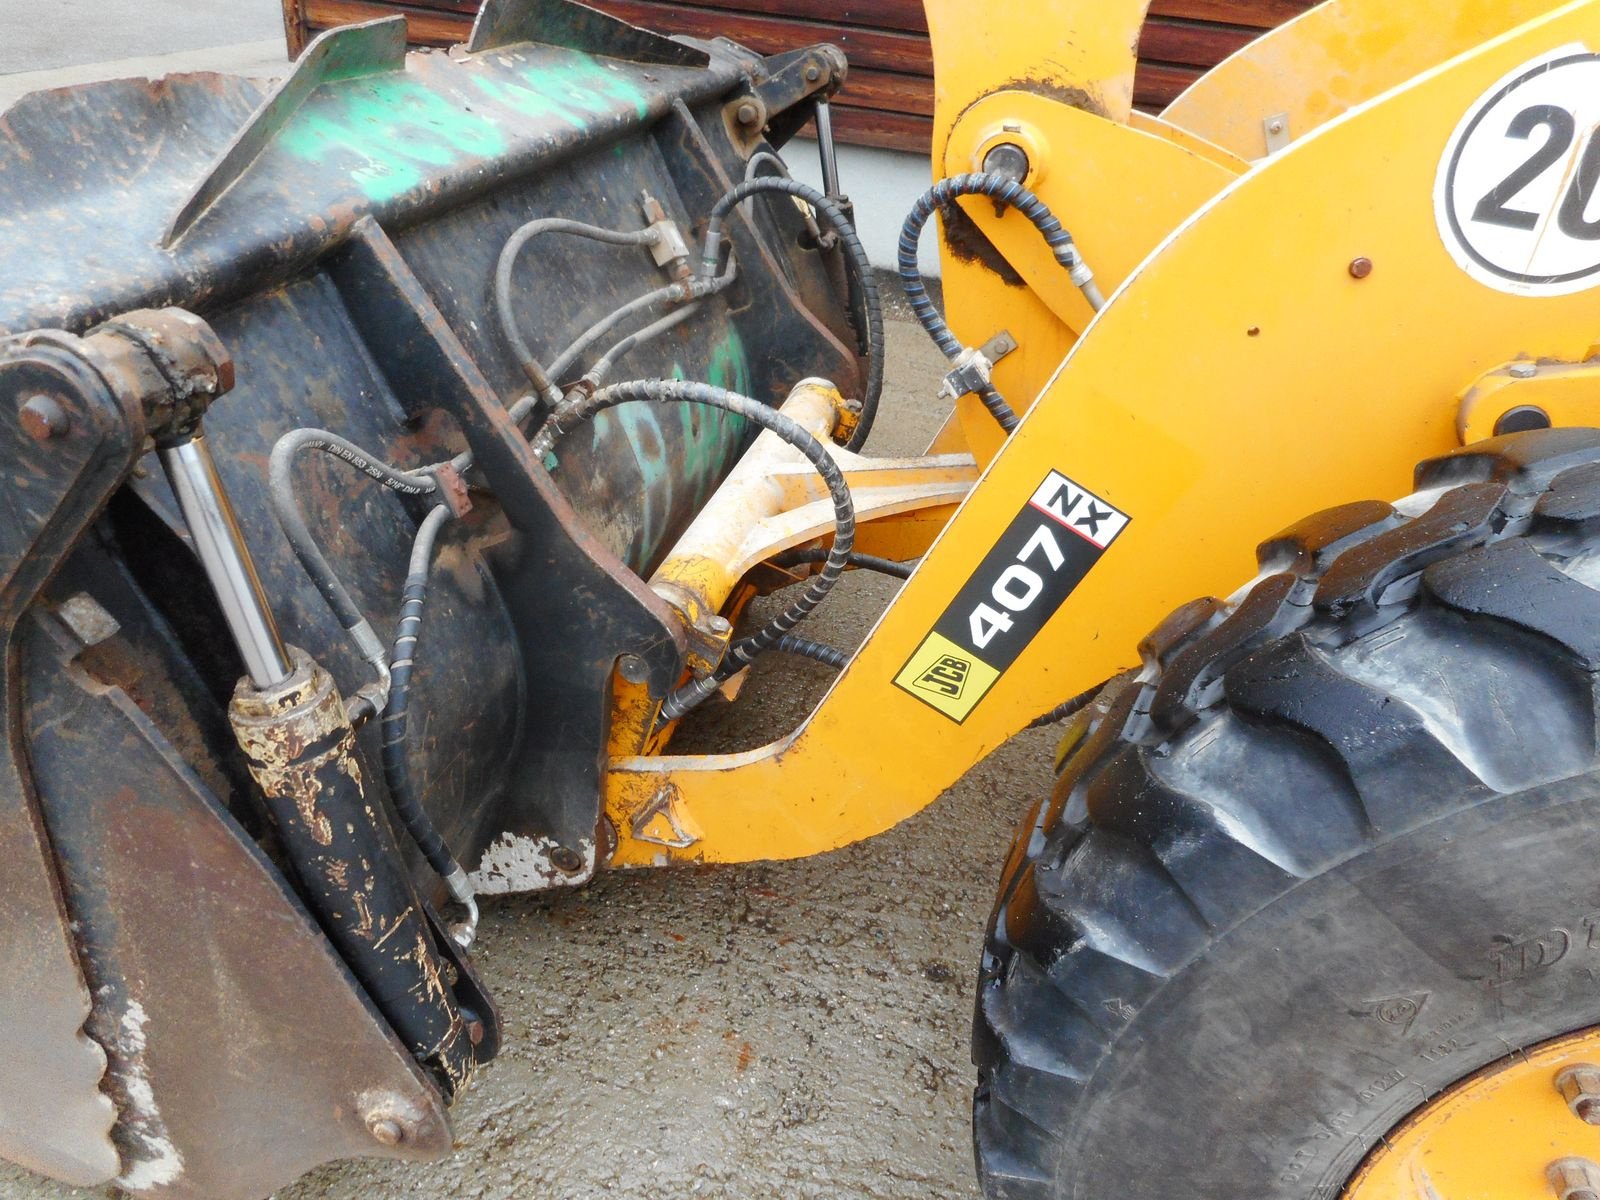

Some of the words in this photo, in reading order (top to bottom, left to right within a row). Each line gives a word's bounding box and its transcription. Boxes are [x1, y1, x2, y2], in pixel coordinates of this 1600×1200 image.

[327, 443, 344, 455] DIN
[340, 449, 355, 461] EN
[365, 465, 383, 479] 2SN
[922, 657, 967, 696] JCB
[969, 523, 1065, 650] 407
